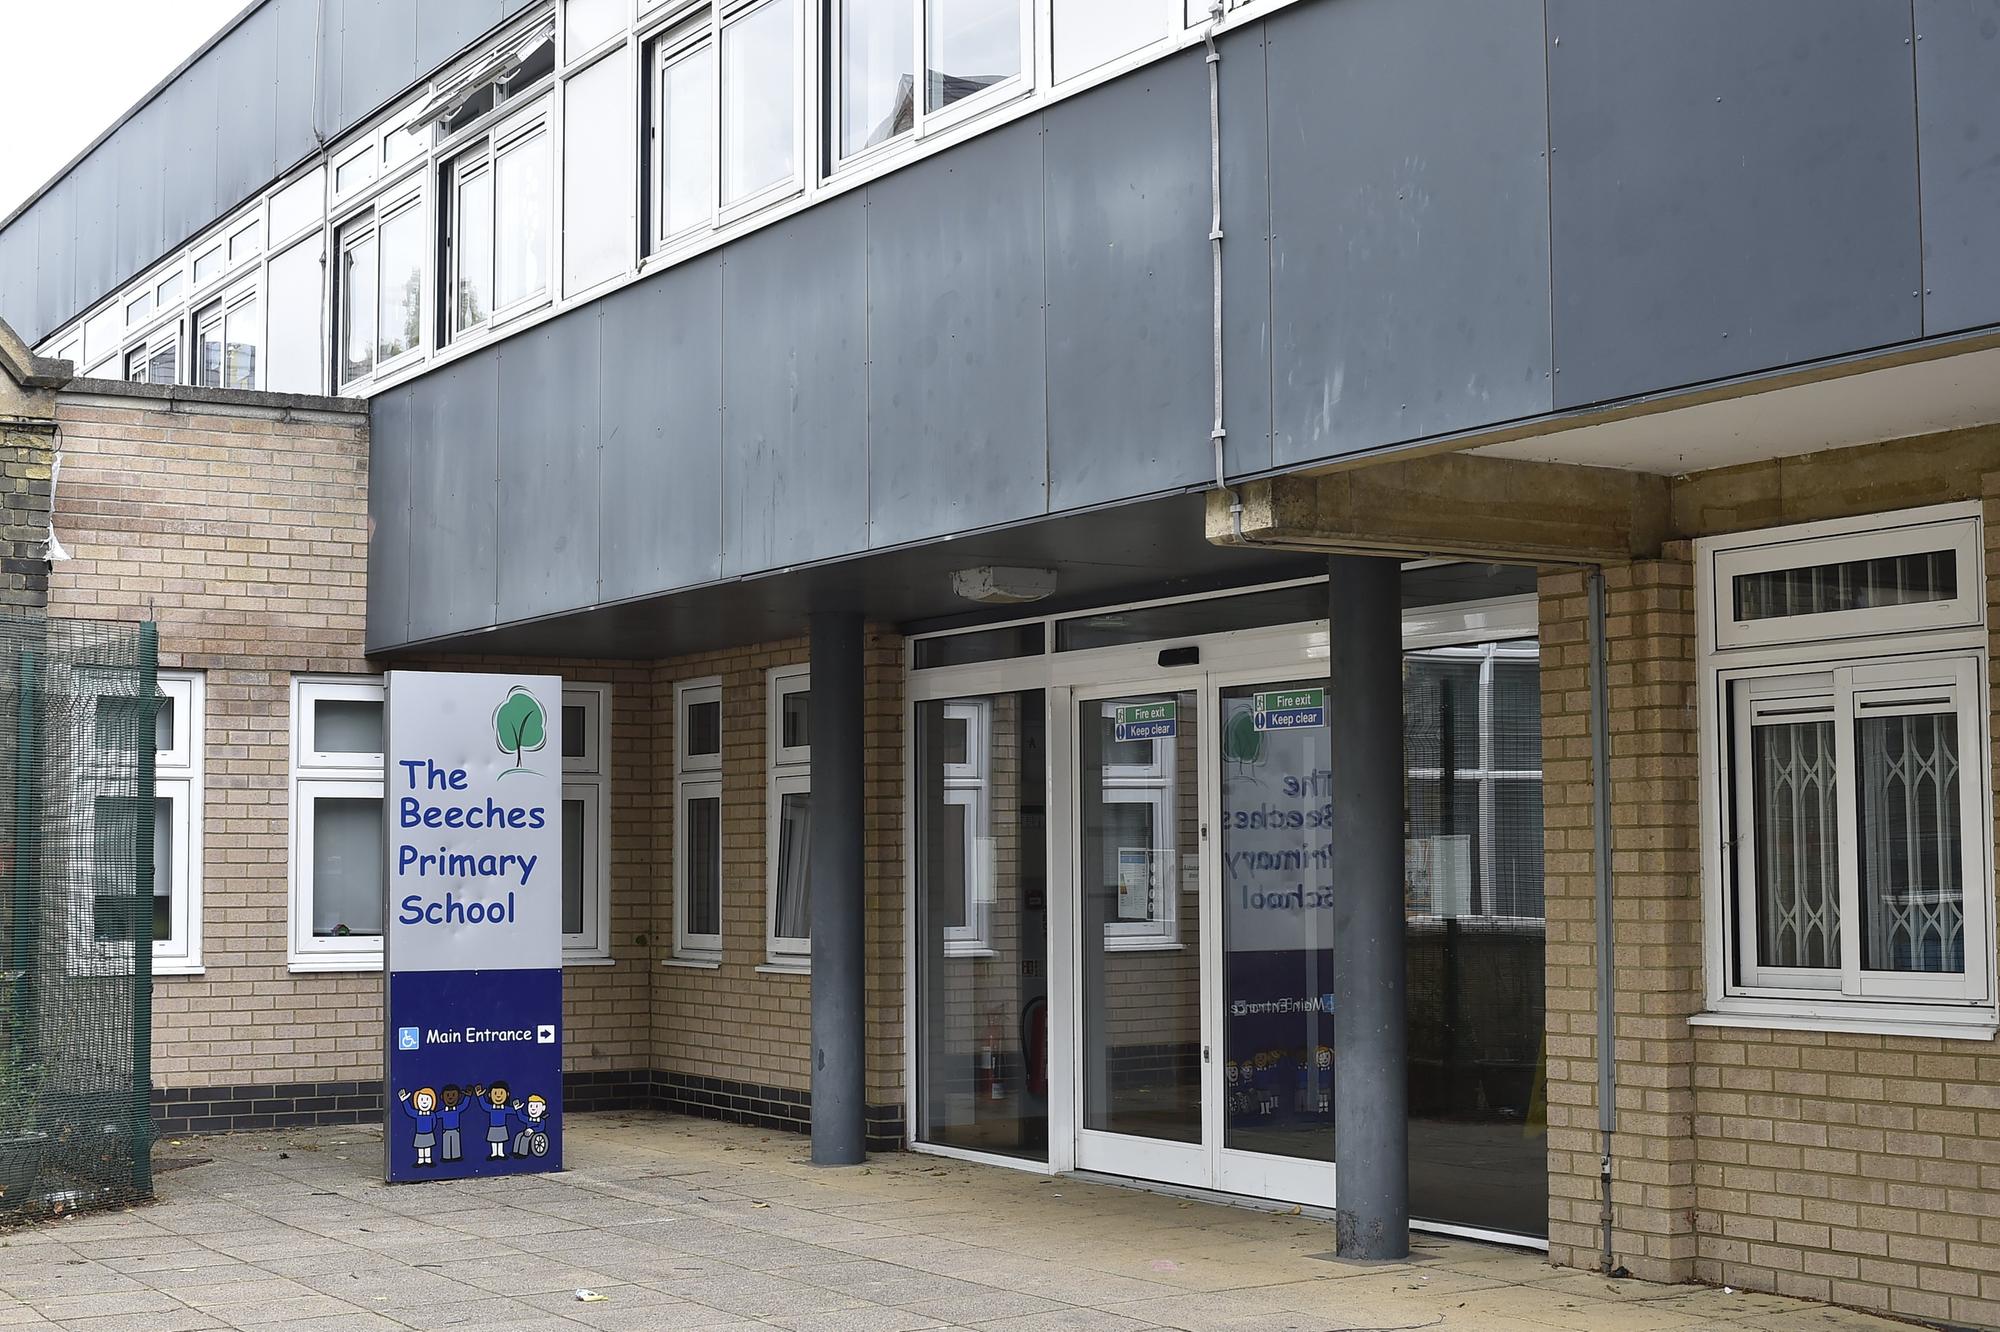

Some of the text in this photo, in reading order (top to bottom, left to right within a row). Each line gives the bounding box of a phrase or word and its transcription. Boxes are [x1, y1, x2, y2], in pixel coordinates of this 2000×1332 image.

[1277, 694, 1312, 707] Fire exit
[1135, 707, 1165, 720] Fire exit
[1271, 712, 1317, 728] Keep clear
[1130, 724, 1170, 738] Keep clear
[399, 759, 468, 790] The
[400, 797, 545, 829] Beeches
[399, 845, 538, 885] Primary
[399, 892, 514, 925] School
[426, 1027, 532, 1044] Main Entrance
